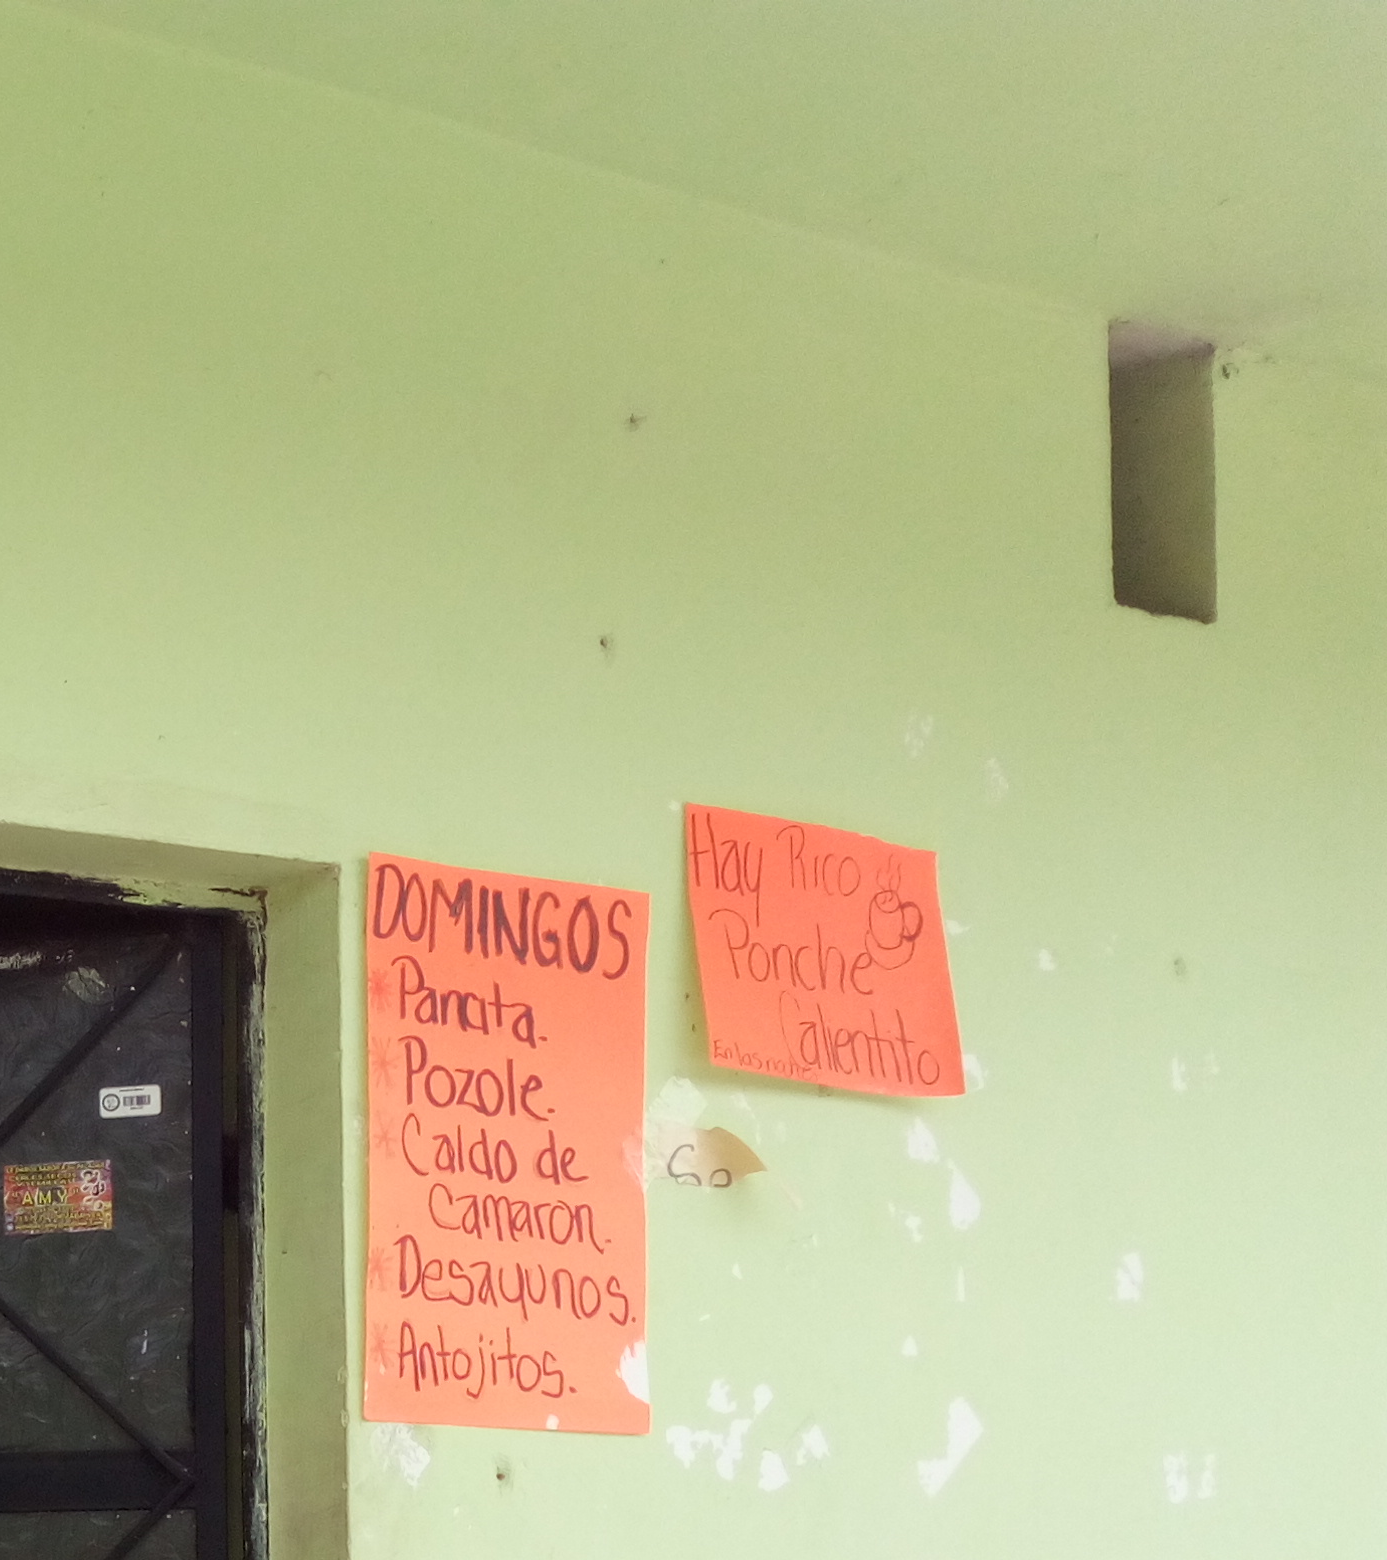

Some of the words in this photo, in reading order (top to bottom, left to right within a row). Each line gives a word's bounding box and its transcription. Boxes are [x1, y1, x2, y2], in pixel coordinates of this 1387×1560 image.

[689, 812, 764, 928] Hay
[373, 862, 632, 981] DOMINGOS
[707, 907, 874, 996] Ponche
[401, 1111, 518, 1184] Caldo
[535, 1129, 590, 1185] de
